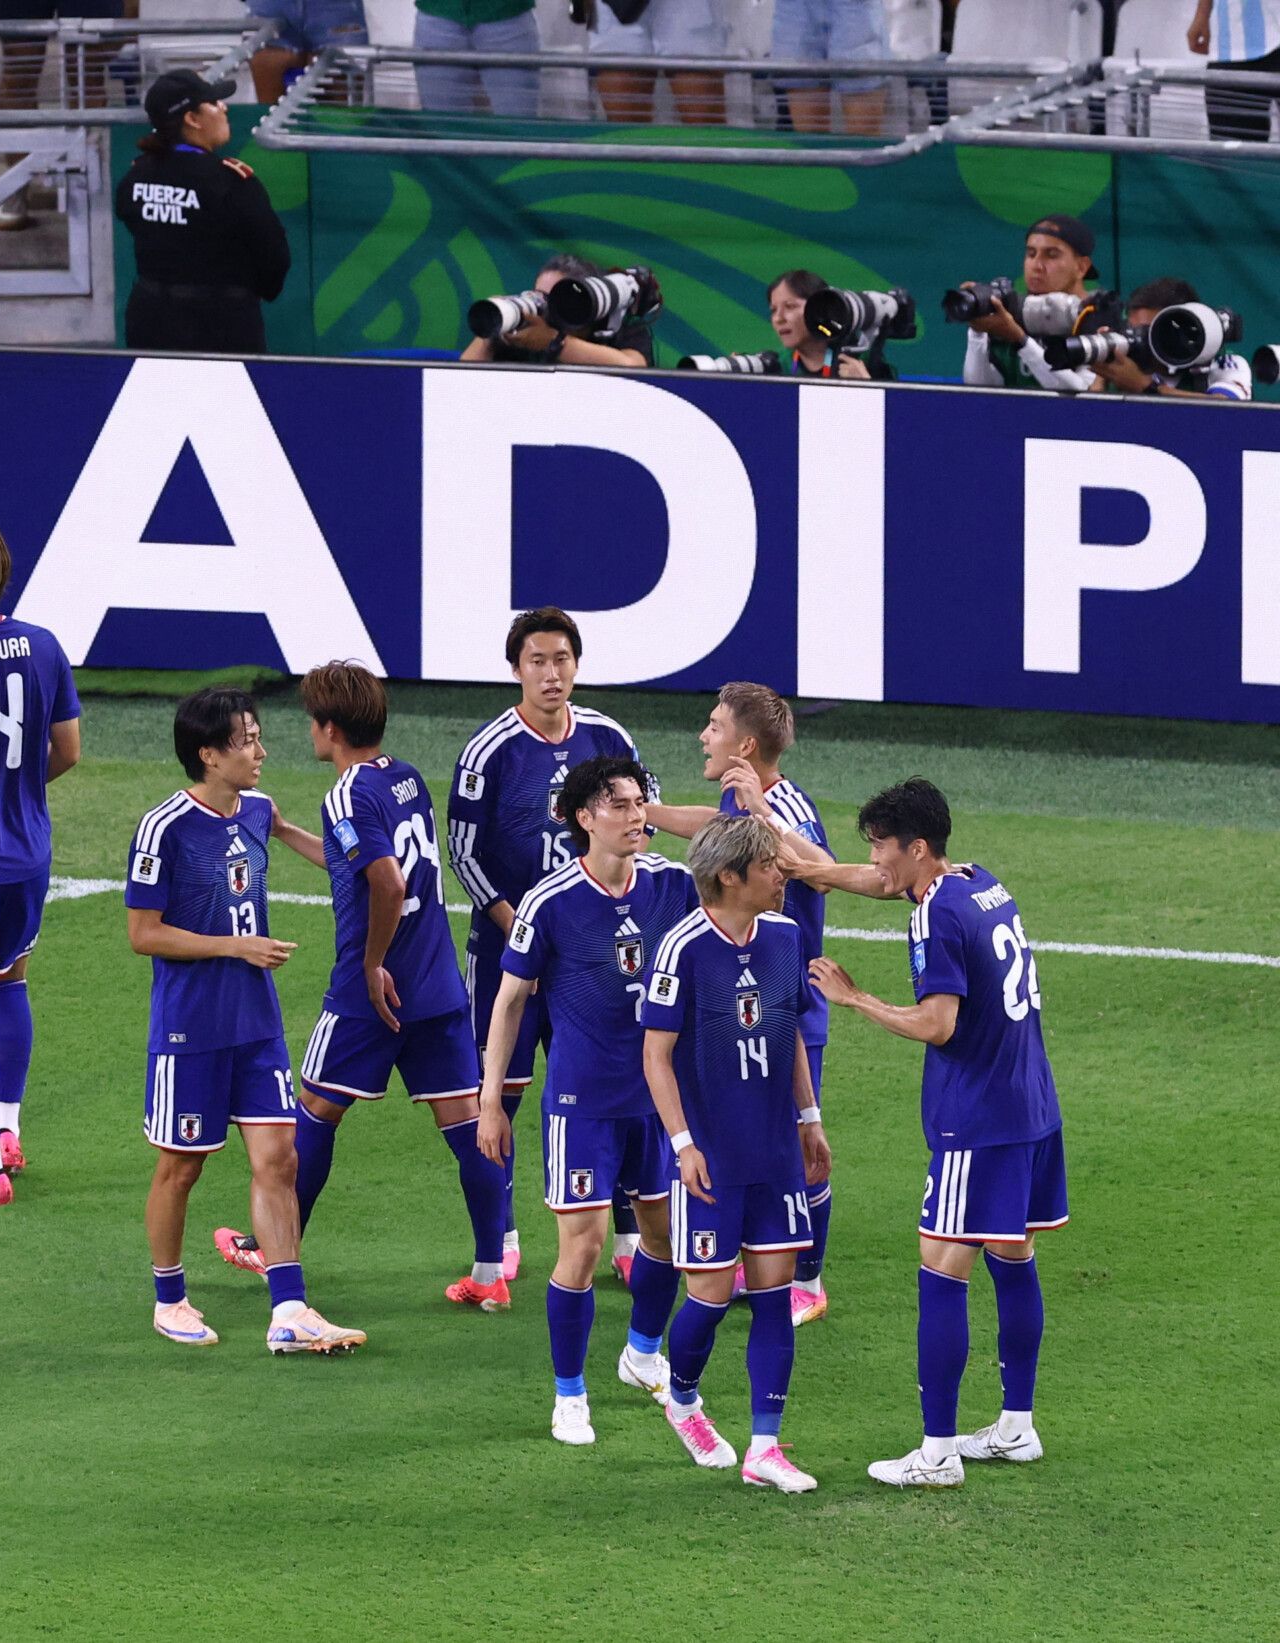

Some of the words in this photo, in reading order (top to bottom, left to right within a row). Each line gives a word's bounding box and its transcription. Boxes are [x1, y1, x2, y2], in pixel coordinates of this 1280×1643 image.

[133, 182, 200, 210] FUERZA
[142, 202, 188, 225] CIVIL
[13, 357, 886, 702] ADI
[1023, 437, 1280, 687] P
[393, 807, 443, 917] 24
[541, 831, 572, 871] 15
[228, 900, 258, 937] 13
[737, 1036, 769, 1080] 14
[274, 1069, 296, 1111] 13
[783, 1191, 812, 1235] 14
